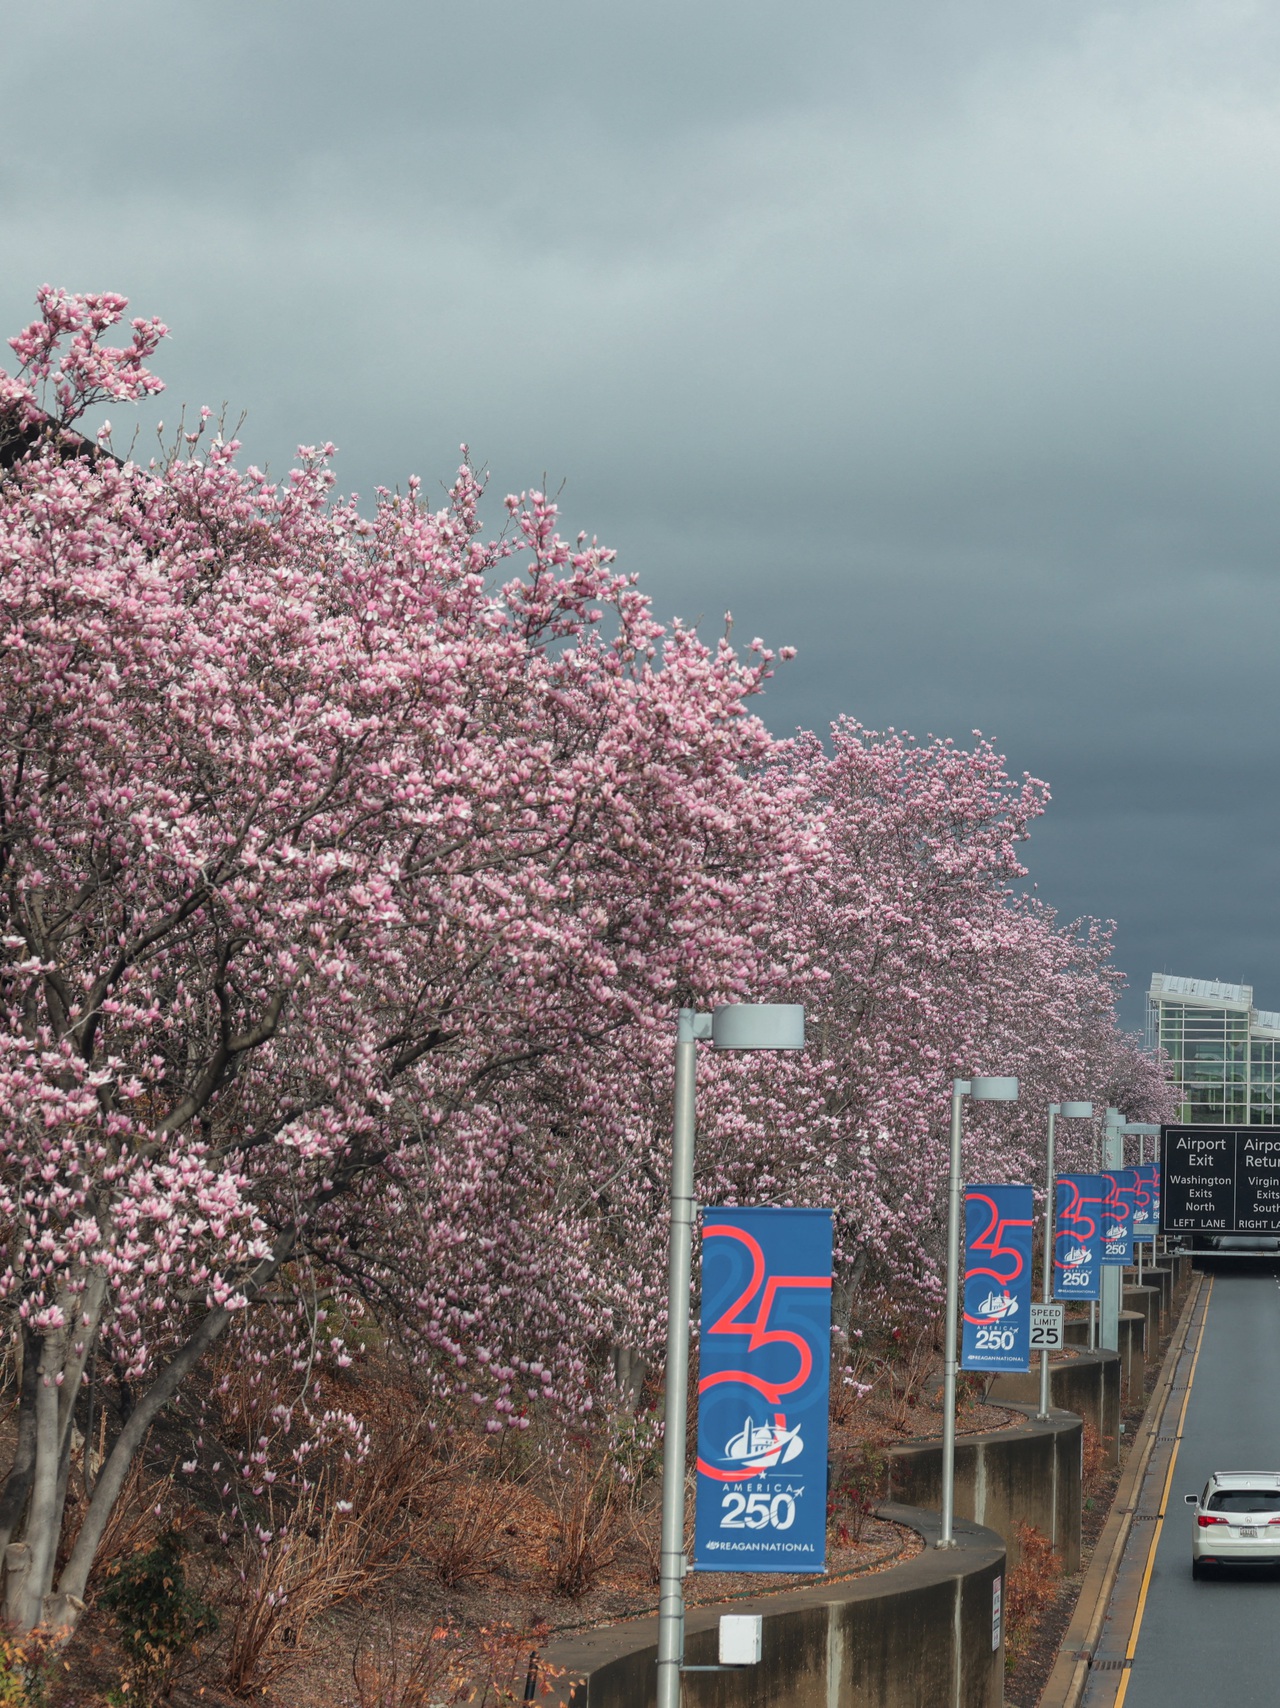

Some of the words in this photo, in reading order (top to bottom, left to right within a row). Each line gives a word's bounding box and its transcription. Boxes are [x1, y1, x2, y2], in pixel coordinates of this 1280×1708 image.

[1176, 1137, 1227, 1153] Airport
[1188, 1154, 1214, 1167] Exit
[1170, 1175, 1232, 1187] Washington
[1189, 1189, 1213, 1198] Exits
[1256, 1190, 1280, 1200] Exits
[1185, 1202, 1215, 1212] North
[1173, 1219, 1195, 1227] LEFT
[1200, 1219, 1226, 1228] LANE
[1238, 1220, 1268, 1229] RIGHT
[1105, 1244, 1126, 1255] 250
[1062, 1273, 1090, 1286] 250
[1031, 1309, 1061, 1317] SPEED
[975, 1330, 1015, 1350] 250
[1031, 1328, 1059, 1344] 25
[722, 1483, 794, 1493] AMERICA
[719, 1492, 796, 1531] 250
